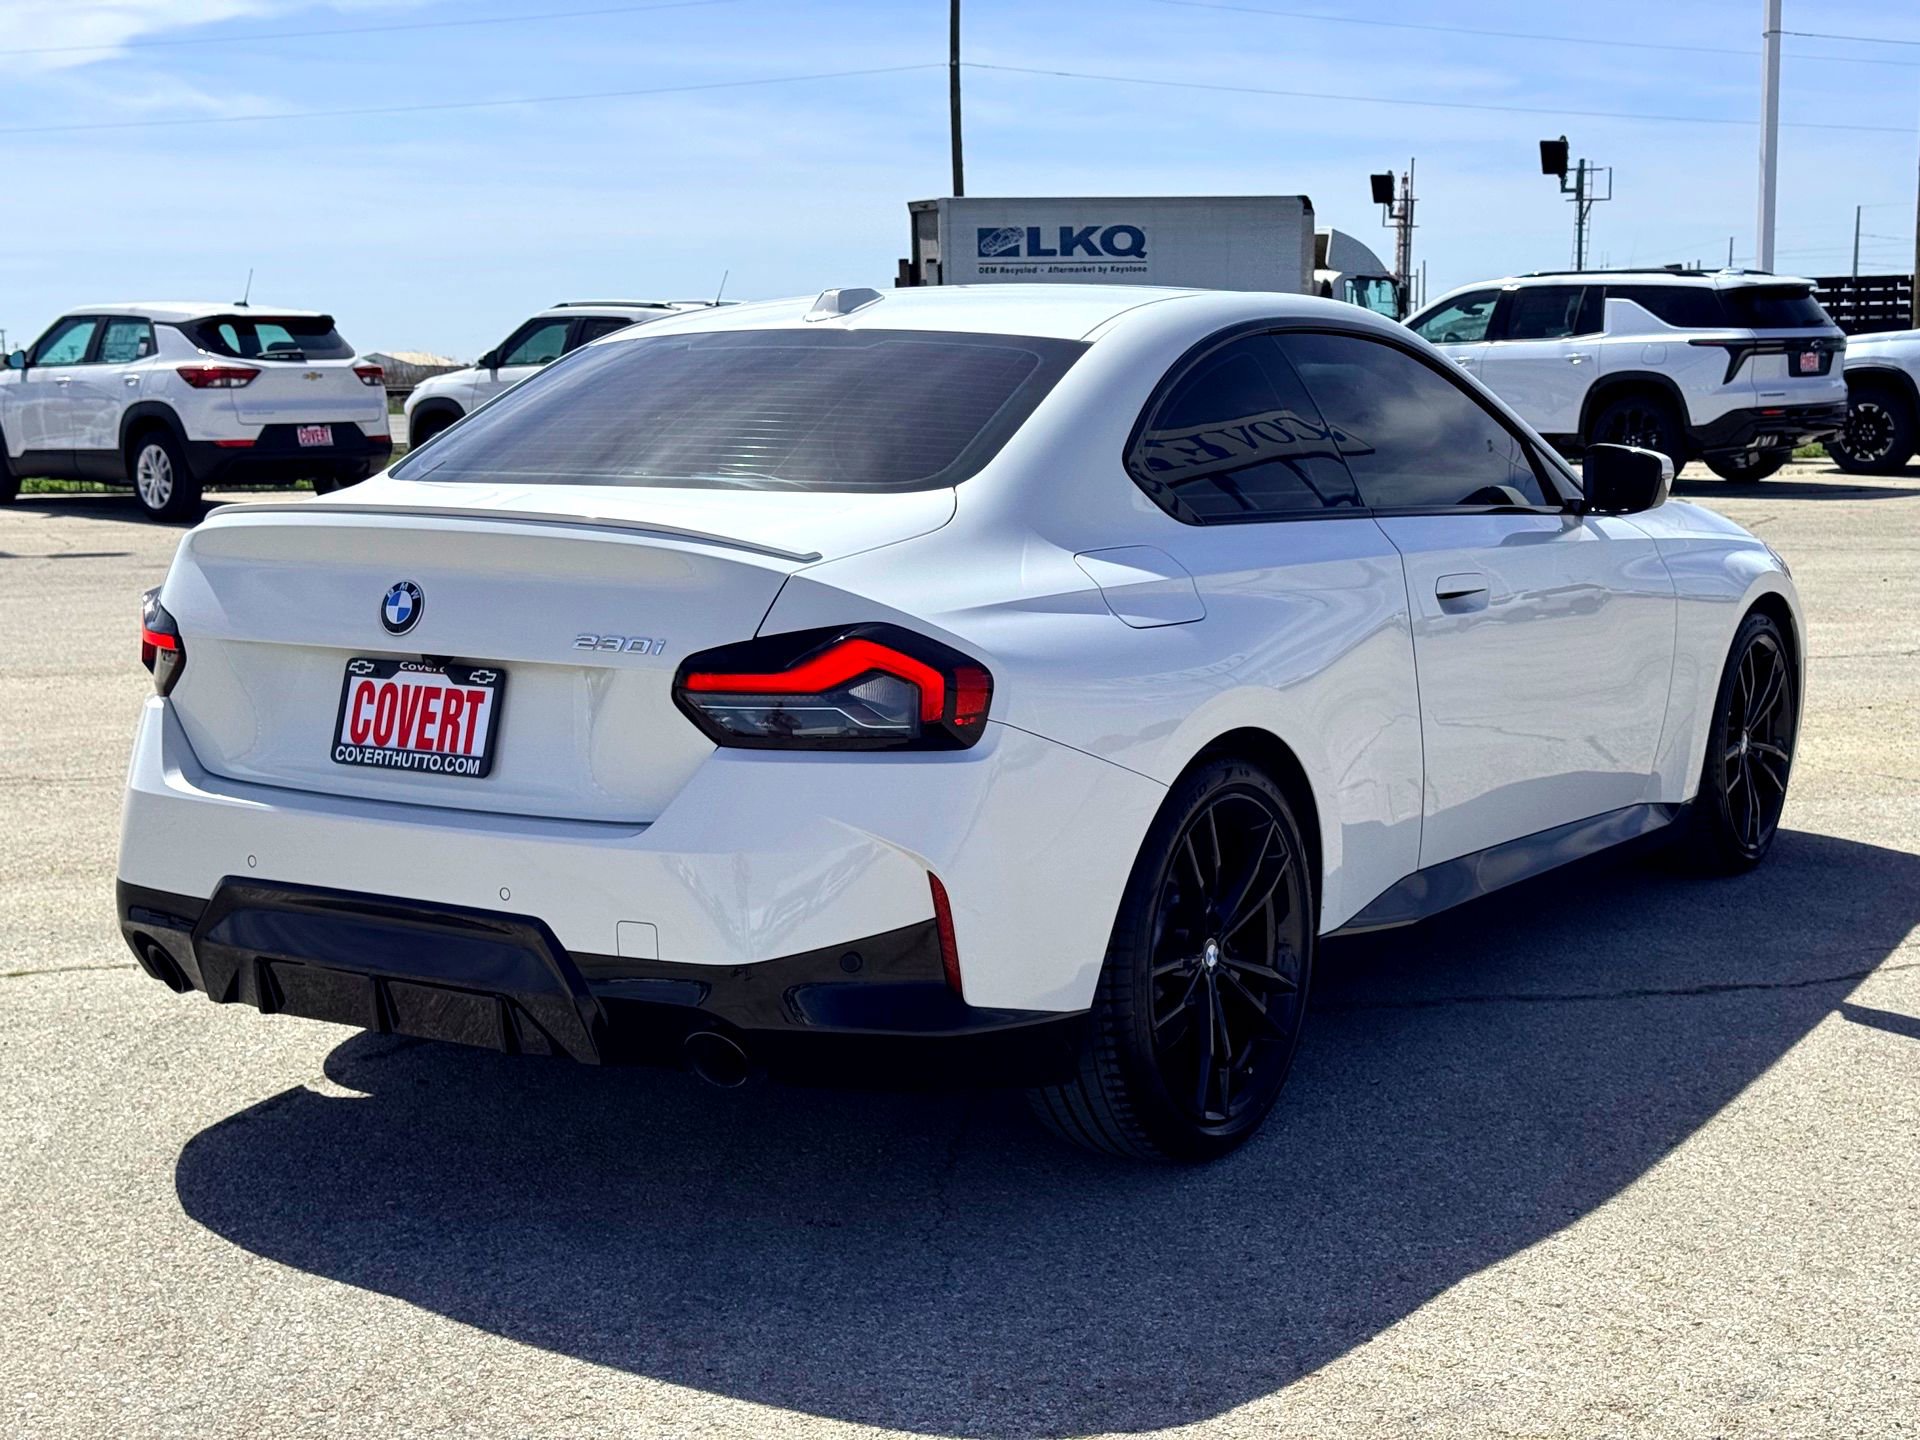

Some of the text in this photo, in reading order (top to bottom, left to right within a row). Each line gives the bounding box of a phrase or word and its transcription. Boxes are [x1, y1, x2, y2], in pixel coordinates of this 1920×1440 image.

[1027, 225, 1147, 258] LKQ
[978, 265, 1148, 276] OEM Recycled Aftermarket by Keystone
[572, 634, 666, 656] 230i
[350, 680, 486, 755] COVERT
[335, 745, 481, 775] COVERTHUTTO.COM
